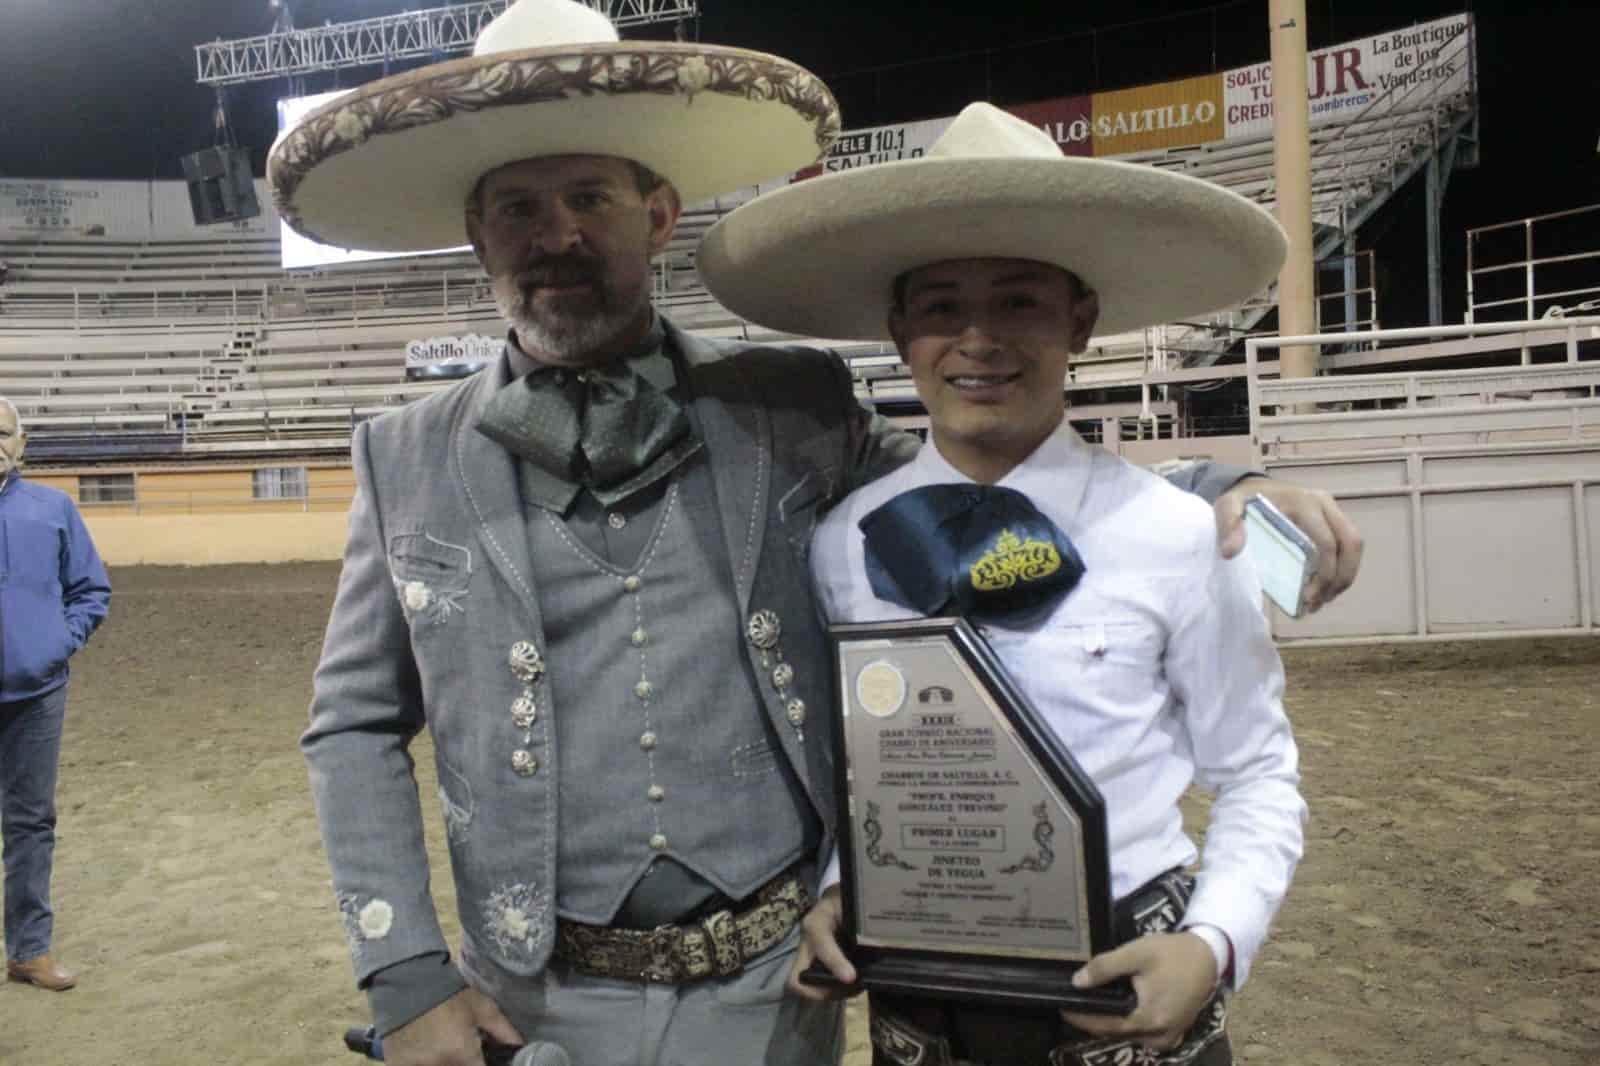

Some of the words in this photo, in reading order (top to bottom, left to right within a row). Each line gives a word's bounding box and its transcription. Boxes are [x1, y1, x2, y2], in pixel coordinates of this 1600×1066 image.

[1373, 39, 1390, 55] La
[1393, 22, 1465, 50] Boutique
[1394, 52, 1413, 69] de
[1226, 66, 1272, 88] SOLIC
[1311, 94, 1370, 114] sombreros
[1096, 100, 1216, 137] SALTILLO
[875, 128, 905, 152] 10.1
